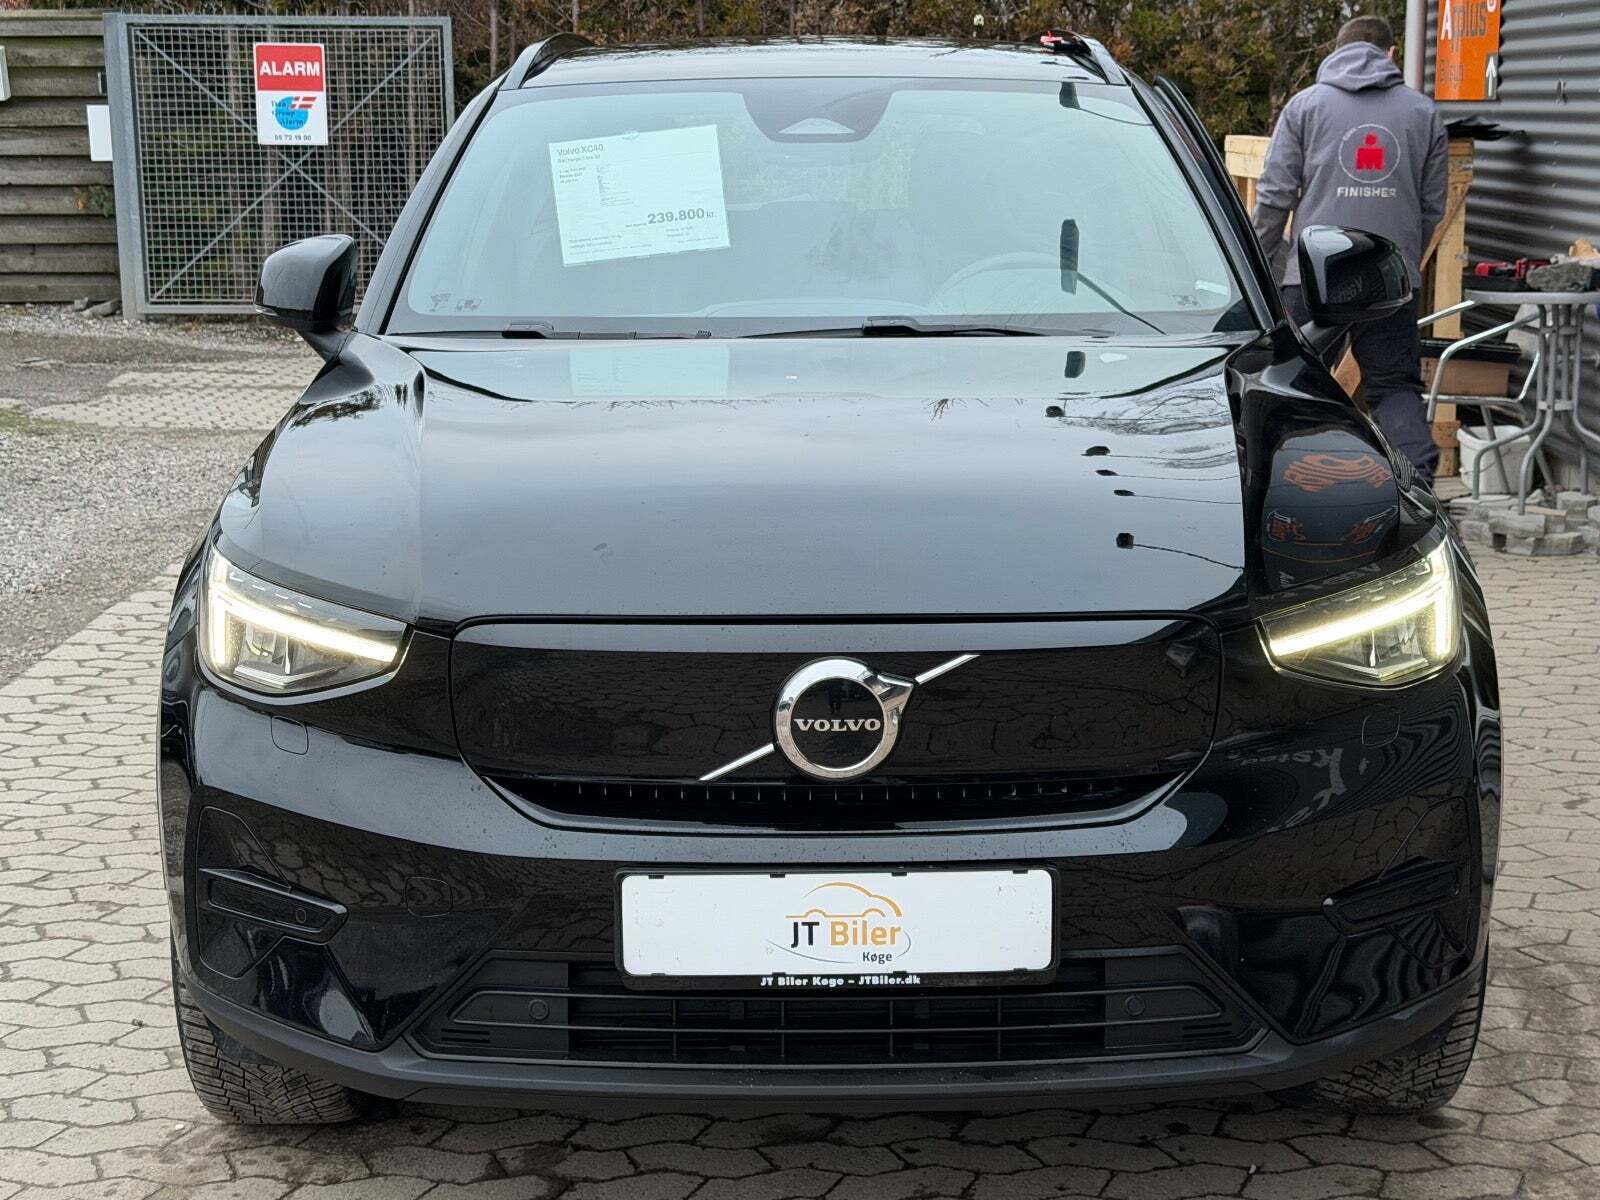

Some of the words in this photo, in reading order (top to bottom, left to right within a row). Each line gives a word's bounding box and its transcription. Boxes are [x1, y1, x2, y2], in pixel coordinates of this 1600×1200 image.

[259, 61, 320, 76] ALARM
[556, 147, 581, 157] Volvo
[582, 143, 604, 154] XC40
[1336, 186, 1397, 199] FINISHER
[647, 207, 705, 225] 239.800
[793, 718, 882, 733] VOLVO
[790, 921, 820, 948] JT
[829, 920, 902, 947] Biler
[862, 952, 893, 965] Køge
[760, 977, 775, 987] JT
[778, 977, 809, 986] Biler
[858, 975, 921, 986] JTBiler.dk
